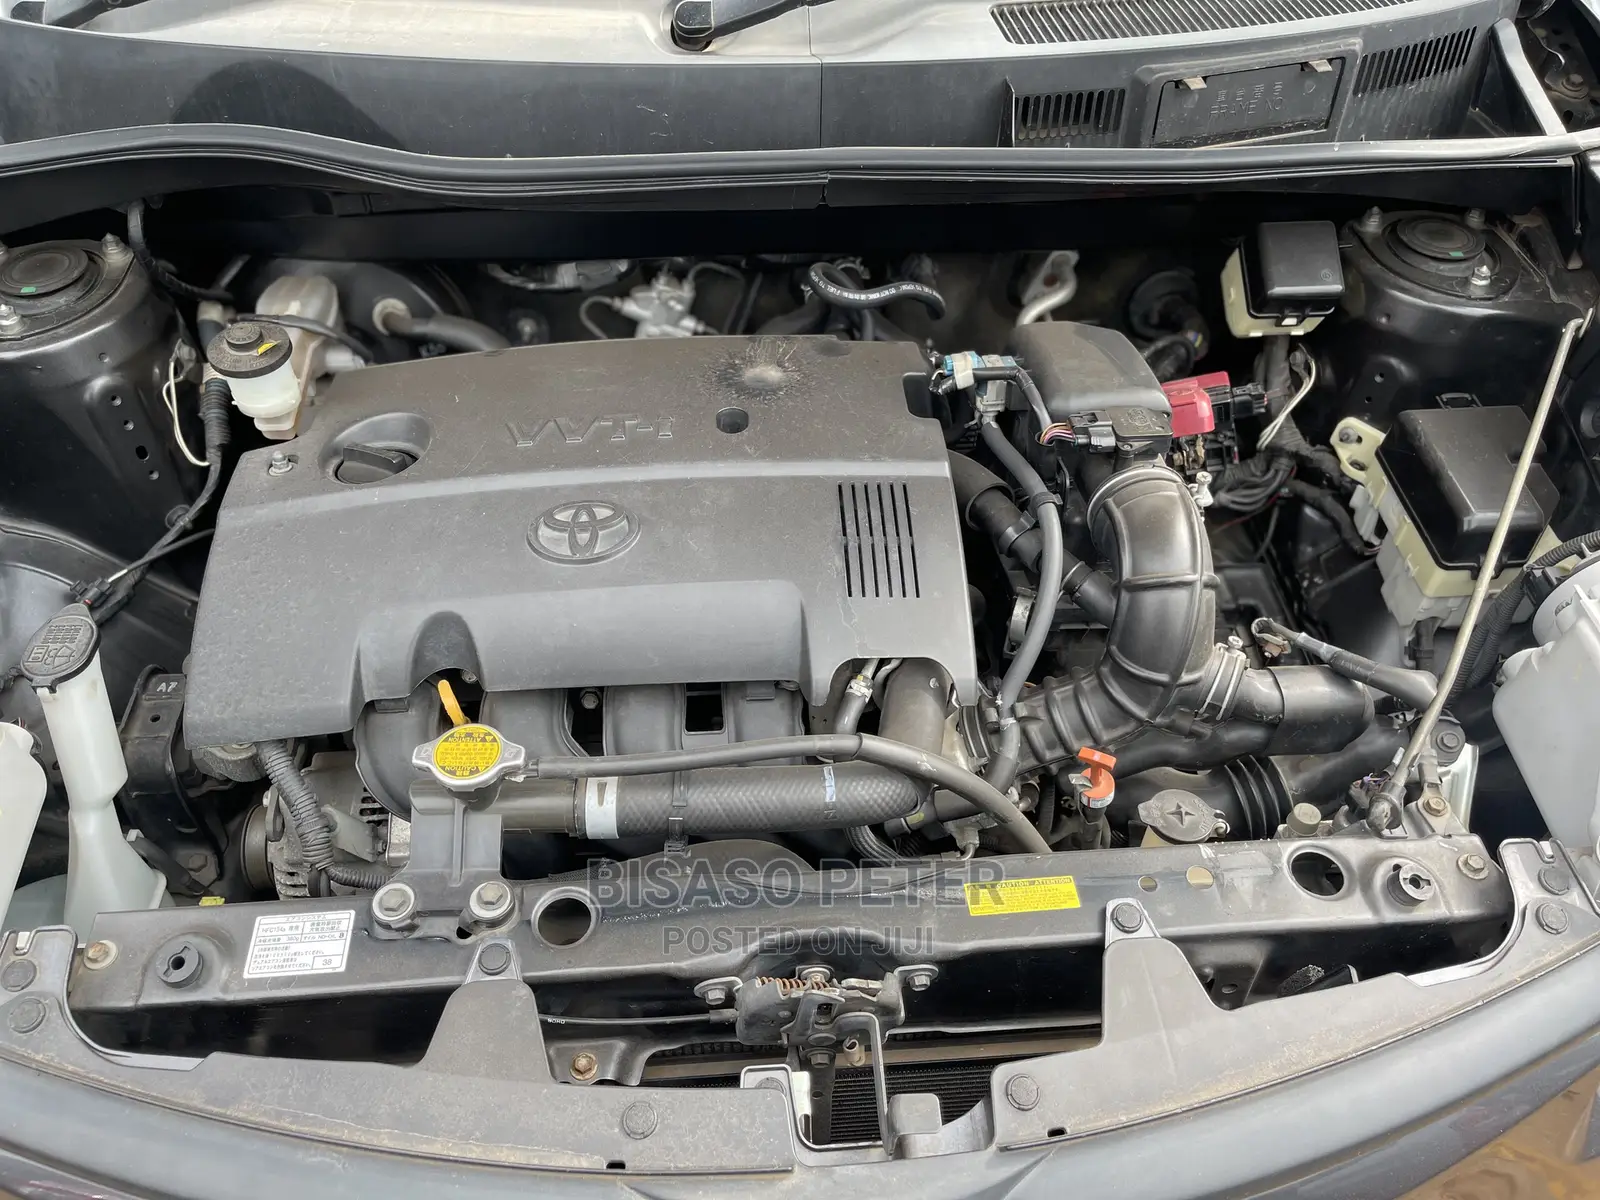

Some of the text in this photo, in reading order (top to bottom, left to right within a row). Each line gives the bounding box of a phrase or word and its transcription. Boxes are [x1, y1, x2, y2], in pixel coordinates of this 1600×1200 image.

[996, 880, 1030, 889] CAUTION
[1034, 877, 1071, 886] ATTENTION
[321, 958, 333, 966] 38
